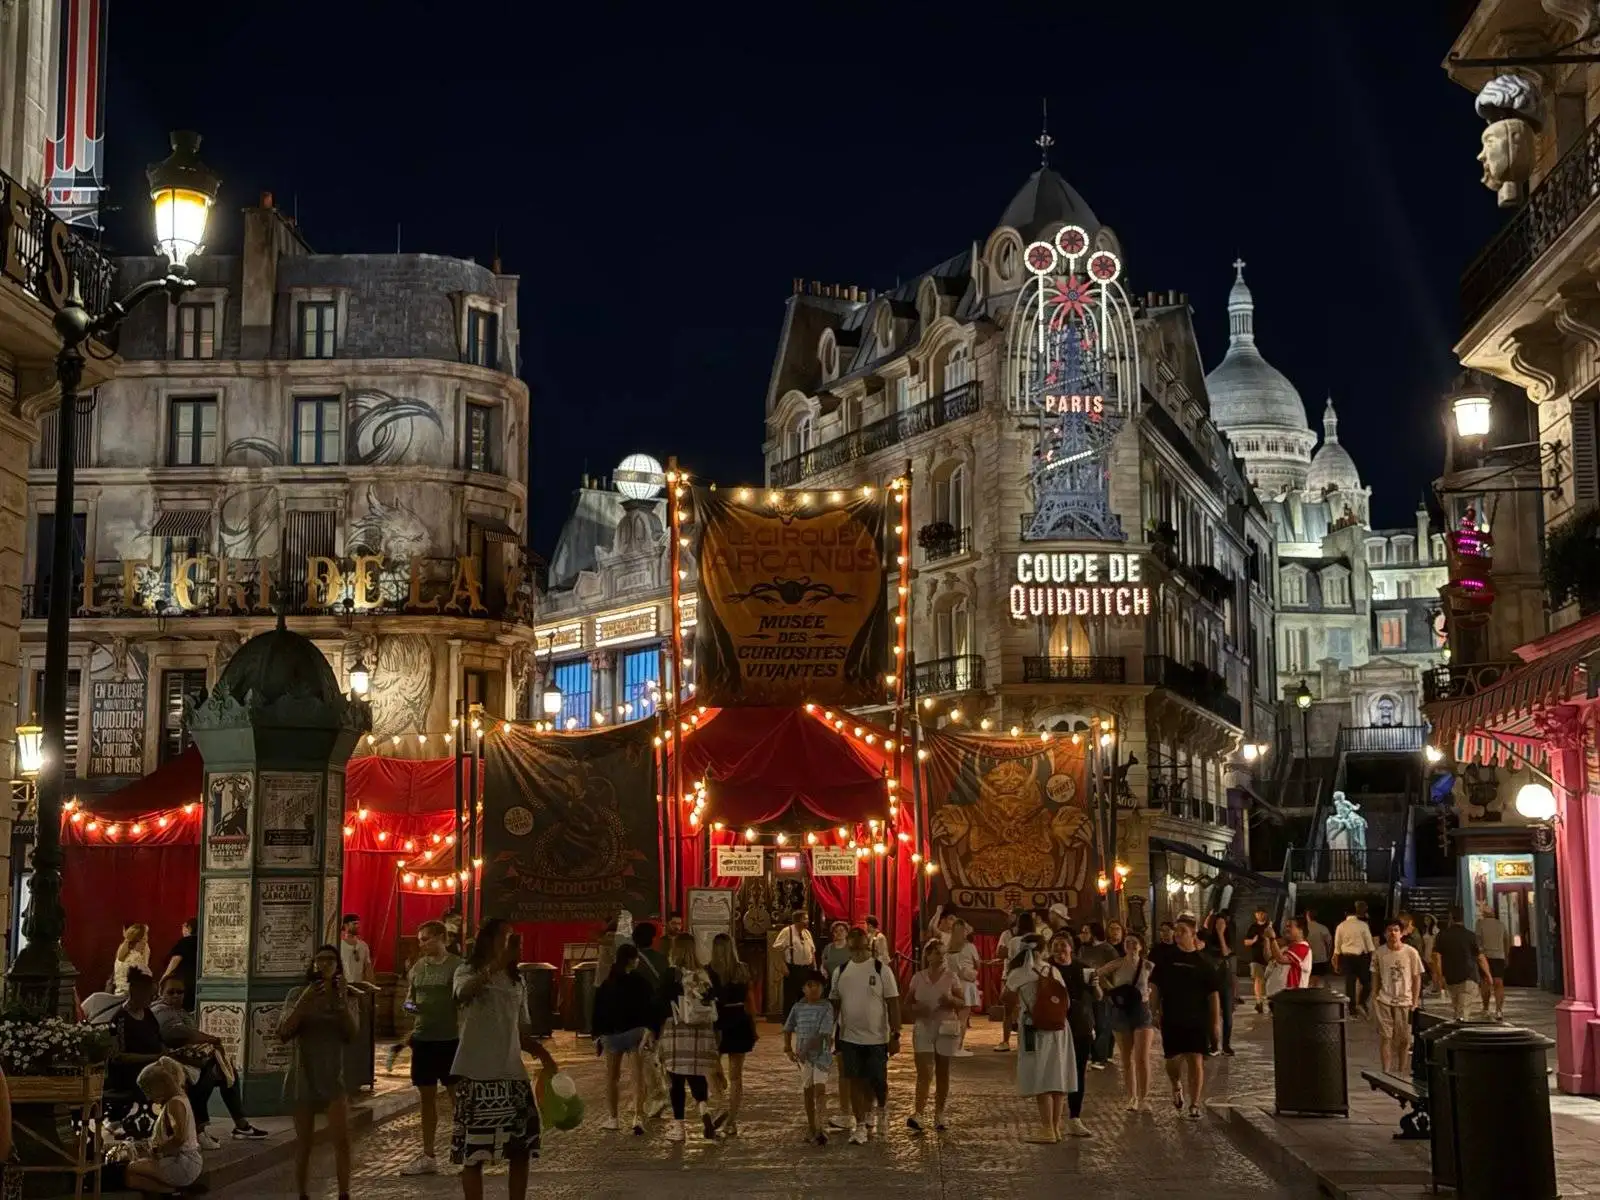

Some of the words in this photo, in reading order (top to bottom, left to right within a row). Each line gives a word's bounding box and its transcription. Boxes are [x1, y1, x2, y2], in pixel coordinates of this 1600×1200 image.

[1045, 395, 1104, 413] PARIS
[754, 527, 856, 547] CIRQUE
[712, 547, 878, 573] ARCANUS
[1016, 553, 1099, 583] COUPE
[1109, 554, 1141, 583] DE
[304, 554, 385, 611] DE
[403, 555, 489, 615] LA
[1010, 585, 1151, 619] QUIDDITCH
[776, 632, 808, 643] DES
[744, 663, 839, 681] VIVANTES
[94, 683, 106, 699] EN
[93, 711, 144, 731] QUIDDITCH
[102, 729, 133, 742] POTIONS
[102, 743, 133, 757] CULTURE
[91, 758, 112, 773] FAITS
[114, 758, 142, 773] DIVERS
[959, 891, 995, 908] ONI
[1033, 891, 1070, 907] ONI
